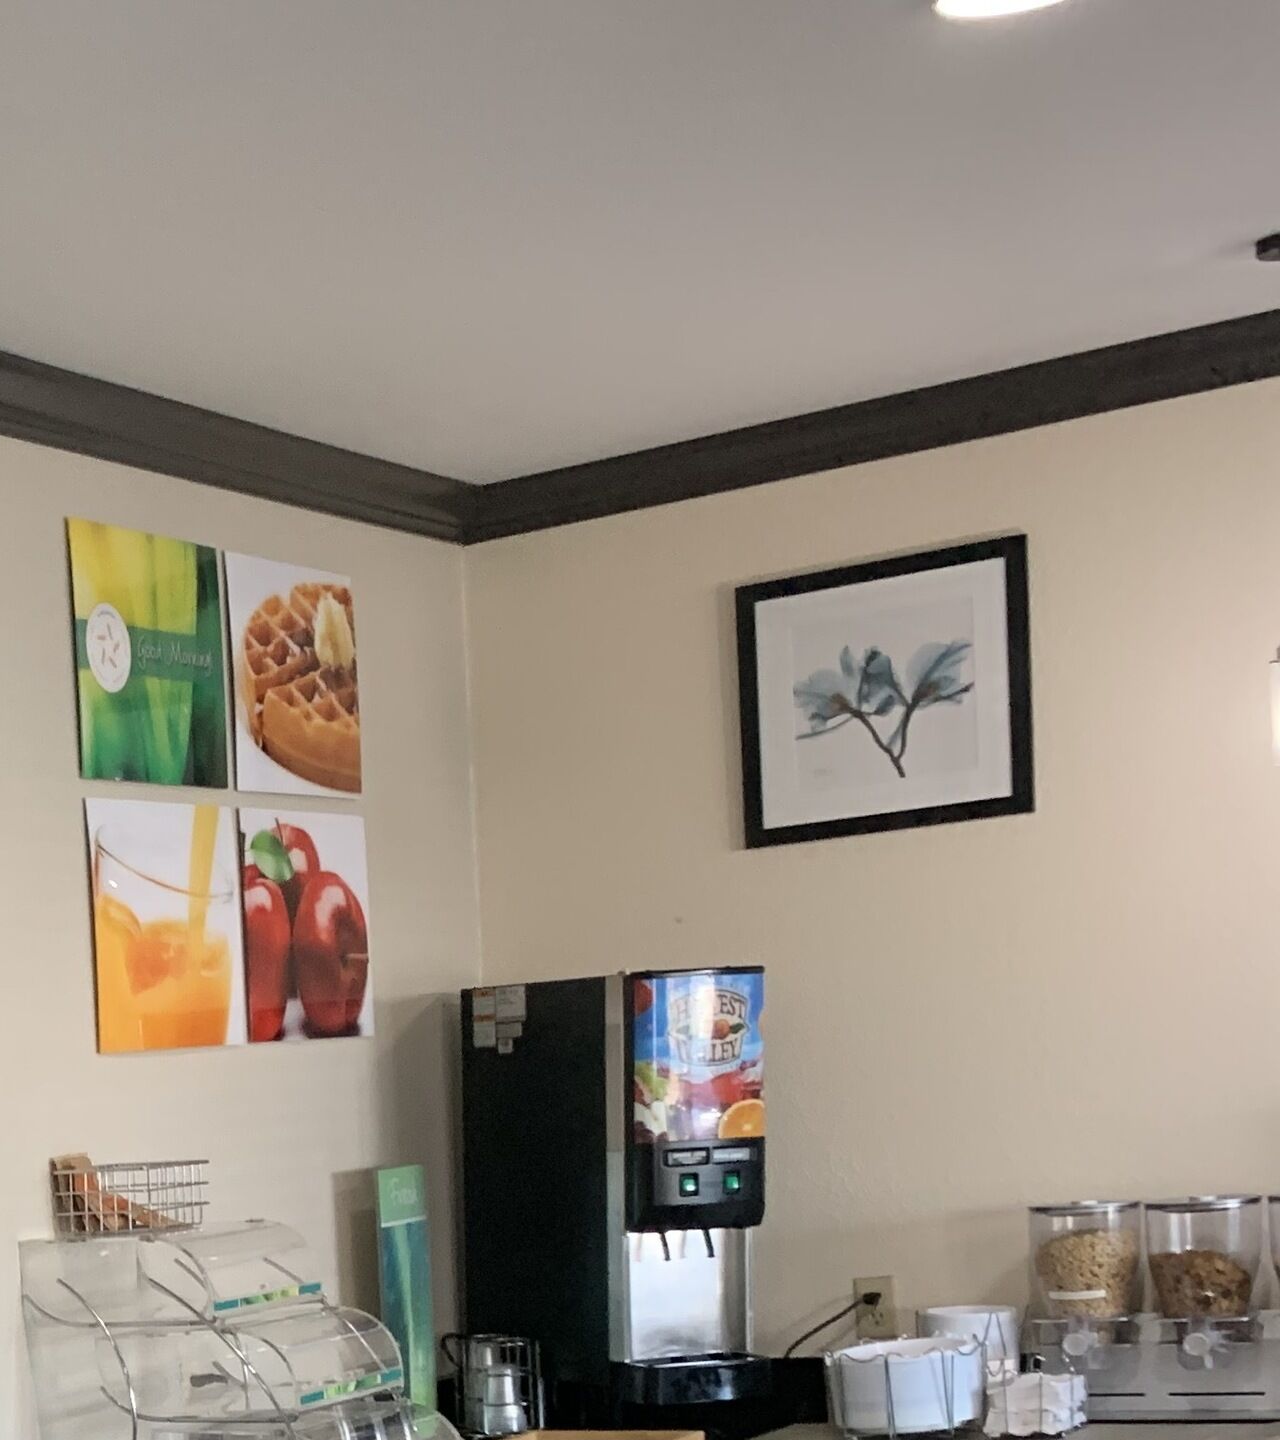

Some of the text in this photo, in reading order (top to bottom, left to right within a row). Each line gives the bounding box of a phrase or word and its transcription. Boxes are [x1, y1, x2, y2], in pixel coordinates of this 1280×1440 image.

[137, 634, 213, 677] Good Morning
[674, 993, 746, 1021] HEST
